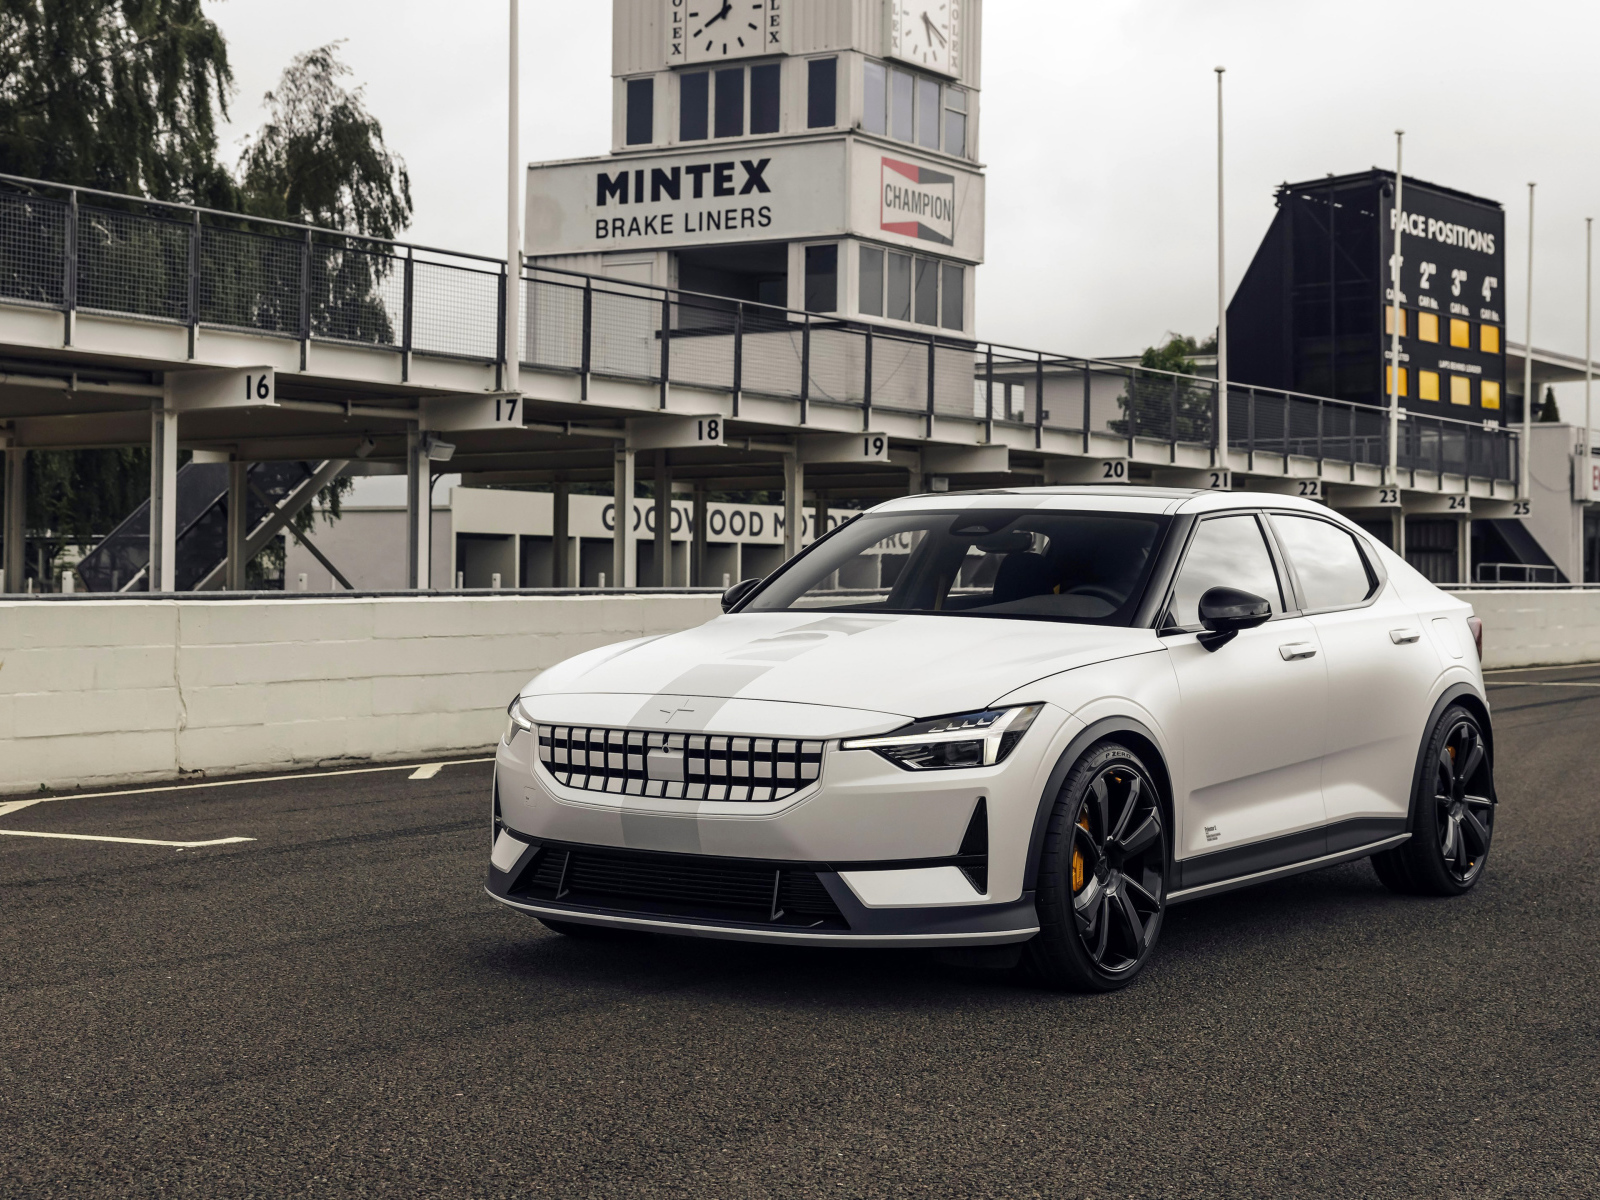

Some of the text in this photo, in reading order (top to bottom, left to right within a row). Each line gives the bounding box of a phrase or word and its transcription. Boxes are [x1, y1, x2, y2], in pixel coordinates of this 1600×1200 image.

[596, 158, 772, 206] MINTEX
[884, 183, 951, 222] CHAMPION
[595, 206, 772, 239] BRAKE LINERS
[1427, 217, 1496, 255] POSITIONS
[246, 374, 270, 400] 16
[495, 398, 518, 422] 17
[697, 419, 720, 441] 18
[863, 437, 884, 456] 19
[1103, 461, 1124, 479] 20
[1210, 472, 1228, 488] 21
[1298, 481, 1318, 496] 22
[1379, 489, 1397, 503] 23
[1448, 496, 1466, 510] 24
[1513, 502, 1530, 515] 25
[1111, 750, 1131, 759] ZERO
